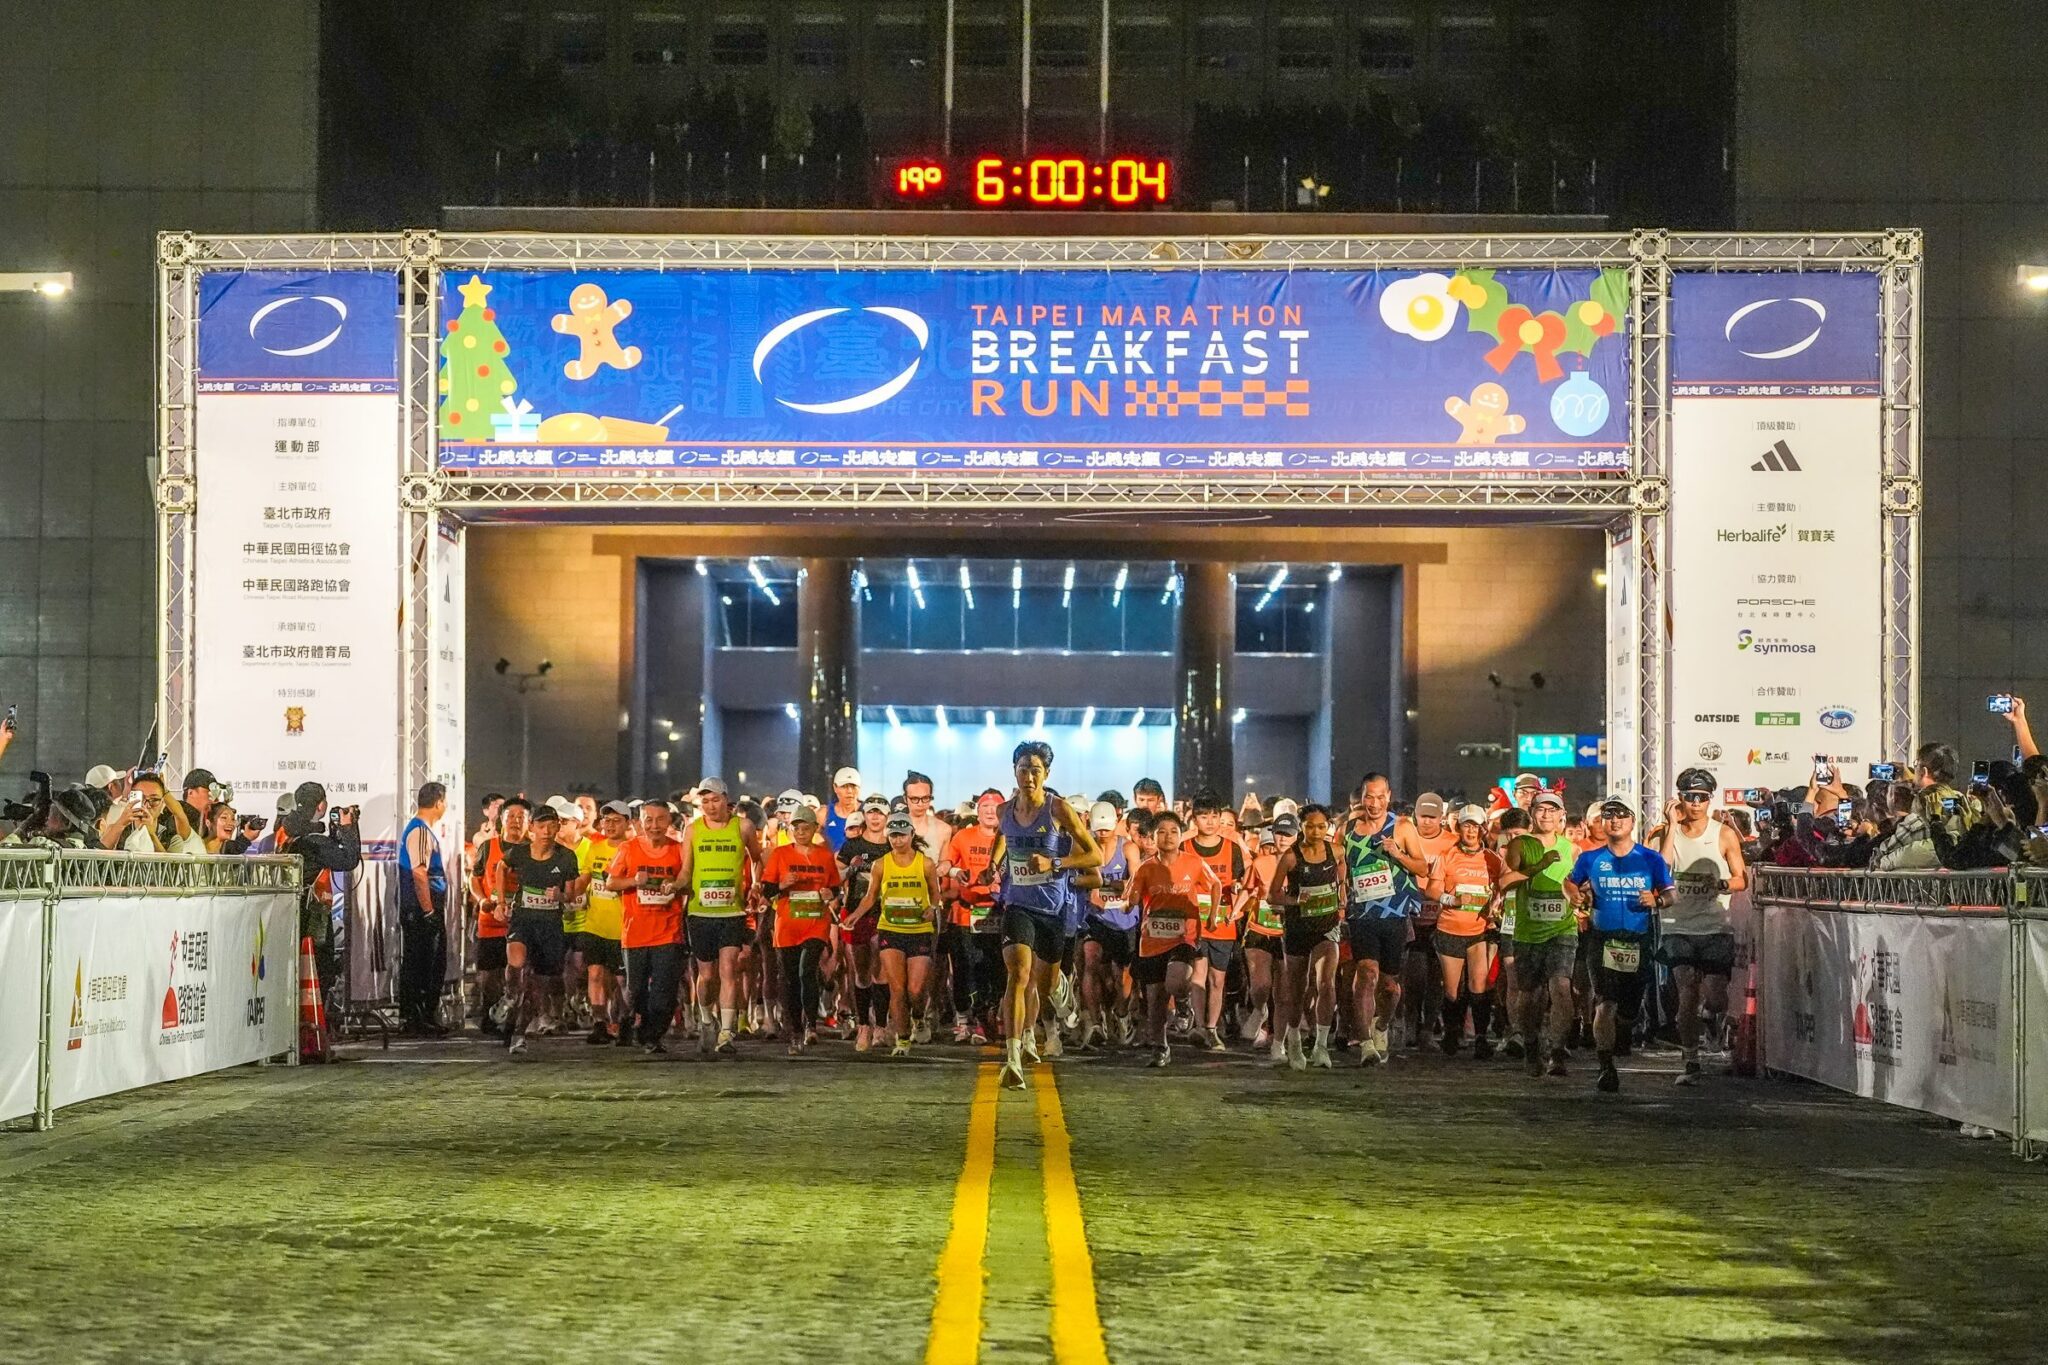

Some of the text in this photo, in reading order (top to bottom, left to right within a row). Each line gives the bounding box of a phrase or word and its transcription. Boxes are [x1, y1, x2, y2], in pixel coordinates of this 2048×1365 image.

[976, 159, 1166, 202] 6:00:04
[971, 305, 1302, 326] TAIPEI MARATHON
[971, 329, 1310, 375] BREAKFAST
[971, 379, 1110, 417] RUN
[277, 417, 317, 428] 指導單位
[274, 440, 320, 453] 運動部
[278, 481, 317, 492] 主辦單位
[263, 507, 331, 520] 臺北市政府
[1717, 528, 1836, 542] Herbalife 賀寶芙
[242, 542, 351, 556] 中華民國田徑協會
[242, 578, 351, 592] 中華民國路跑協會
[1737, 598, 1816, 606] PORSCHE
[242, 645, 351, 659] 臺北市政府體育局
[1753, 643, 1816, 656] synmosa
[1694, 714, 1740, 723] OATSIDE
[1357, 874, 1388, 889] 5293
[703, 890, 732, 900] 8052
[1532, 902, 1562, 914] 5168
[1151, 920, 1180, 931] 6368
